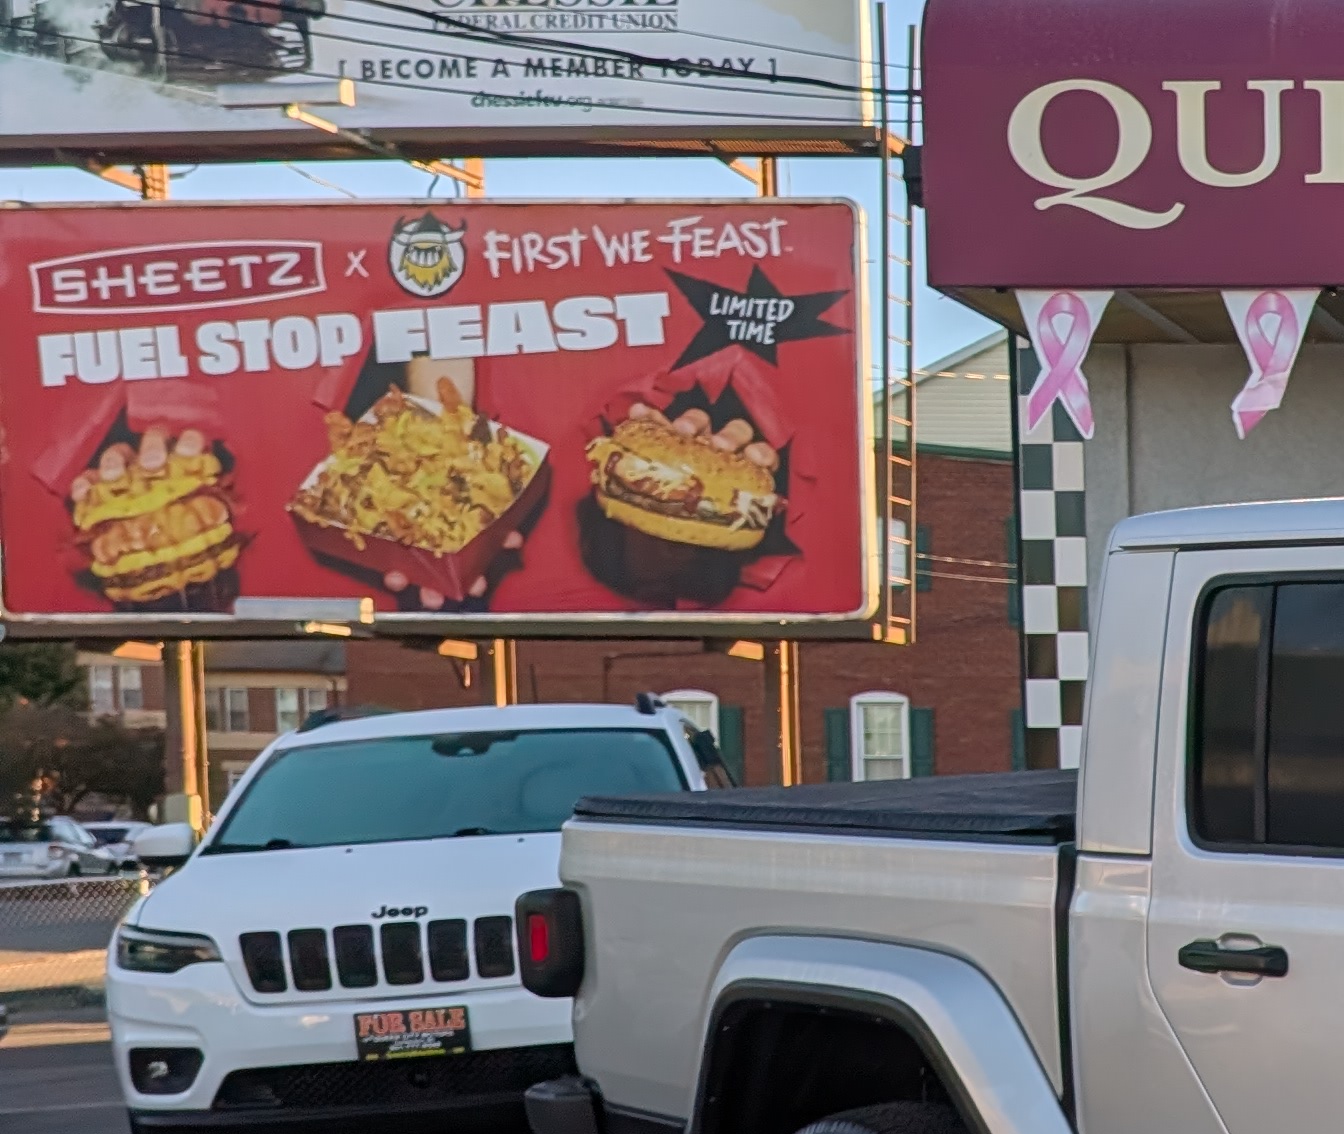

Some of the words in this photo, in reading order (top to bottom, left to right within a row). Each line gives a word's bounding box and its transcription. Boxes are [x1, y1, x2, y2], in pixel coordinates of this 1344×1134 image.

[529, 13, 607, 29] CREDIT
[611, 13, 678, 29] UNION
[360, 57, 478, 80] BECOME
[491, 58, 511, 79] A
[523, 57, 644, 80] MEMBER
[52, 251, 304, 303] SHEETZ
[483, 227, 588, 279] FIRST
[592, 224, 653, 268] WE
[656, 215, 788, 264] FEAST
[708, 291, 796, 324] LIMITED
[38, 324, 190, 387] FUEL
[195, 312, 363, 376] STOP
[372, 292, 671, 364] FEAST
[725, 319, 778, 346] TIME
[371, 904, 429, 919] Jeep
